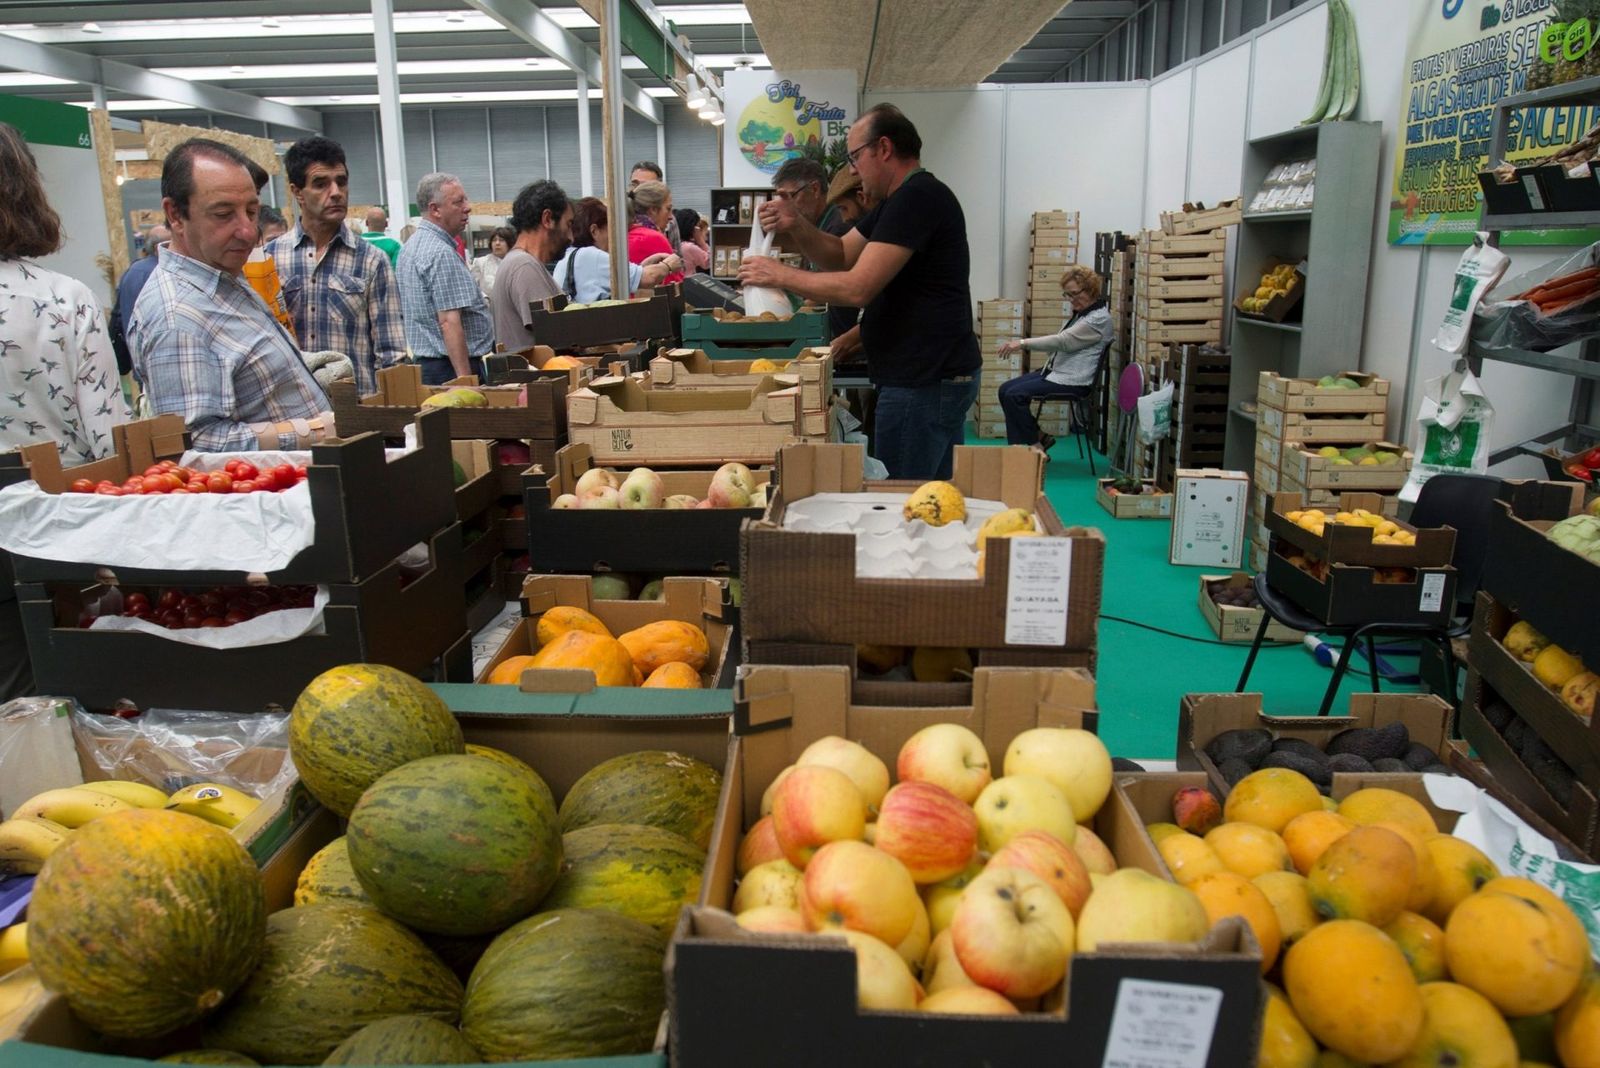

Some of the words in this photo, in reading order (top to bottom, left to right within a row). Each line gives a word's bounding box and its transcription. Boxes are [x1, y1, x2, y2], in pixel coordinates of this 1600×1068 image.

[1410, 52, 1444, 84] FRUTAS
[1445, 48, 1455, 74] Y
[1454, 31, 1512, 72] VERDURAS
[766, 79, 801, 103] Sol
[793, 95, 806, 110] y
[1406, 76, 1458, 123] ALGAS
[1454, 78, 1490, 113] AGUA
[1490, 71, 1511, 105] DE
[797, 101, 846, 126] Fruta
[78, 132, 90, 147] 66
[1399, 162, 1441, 193] FRUTOS
[1440, 156, 1480, 189] SECOS
[611, 429, 632, 440] NATUR
